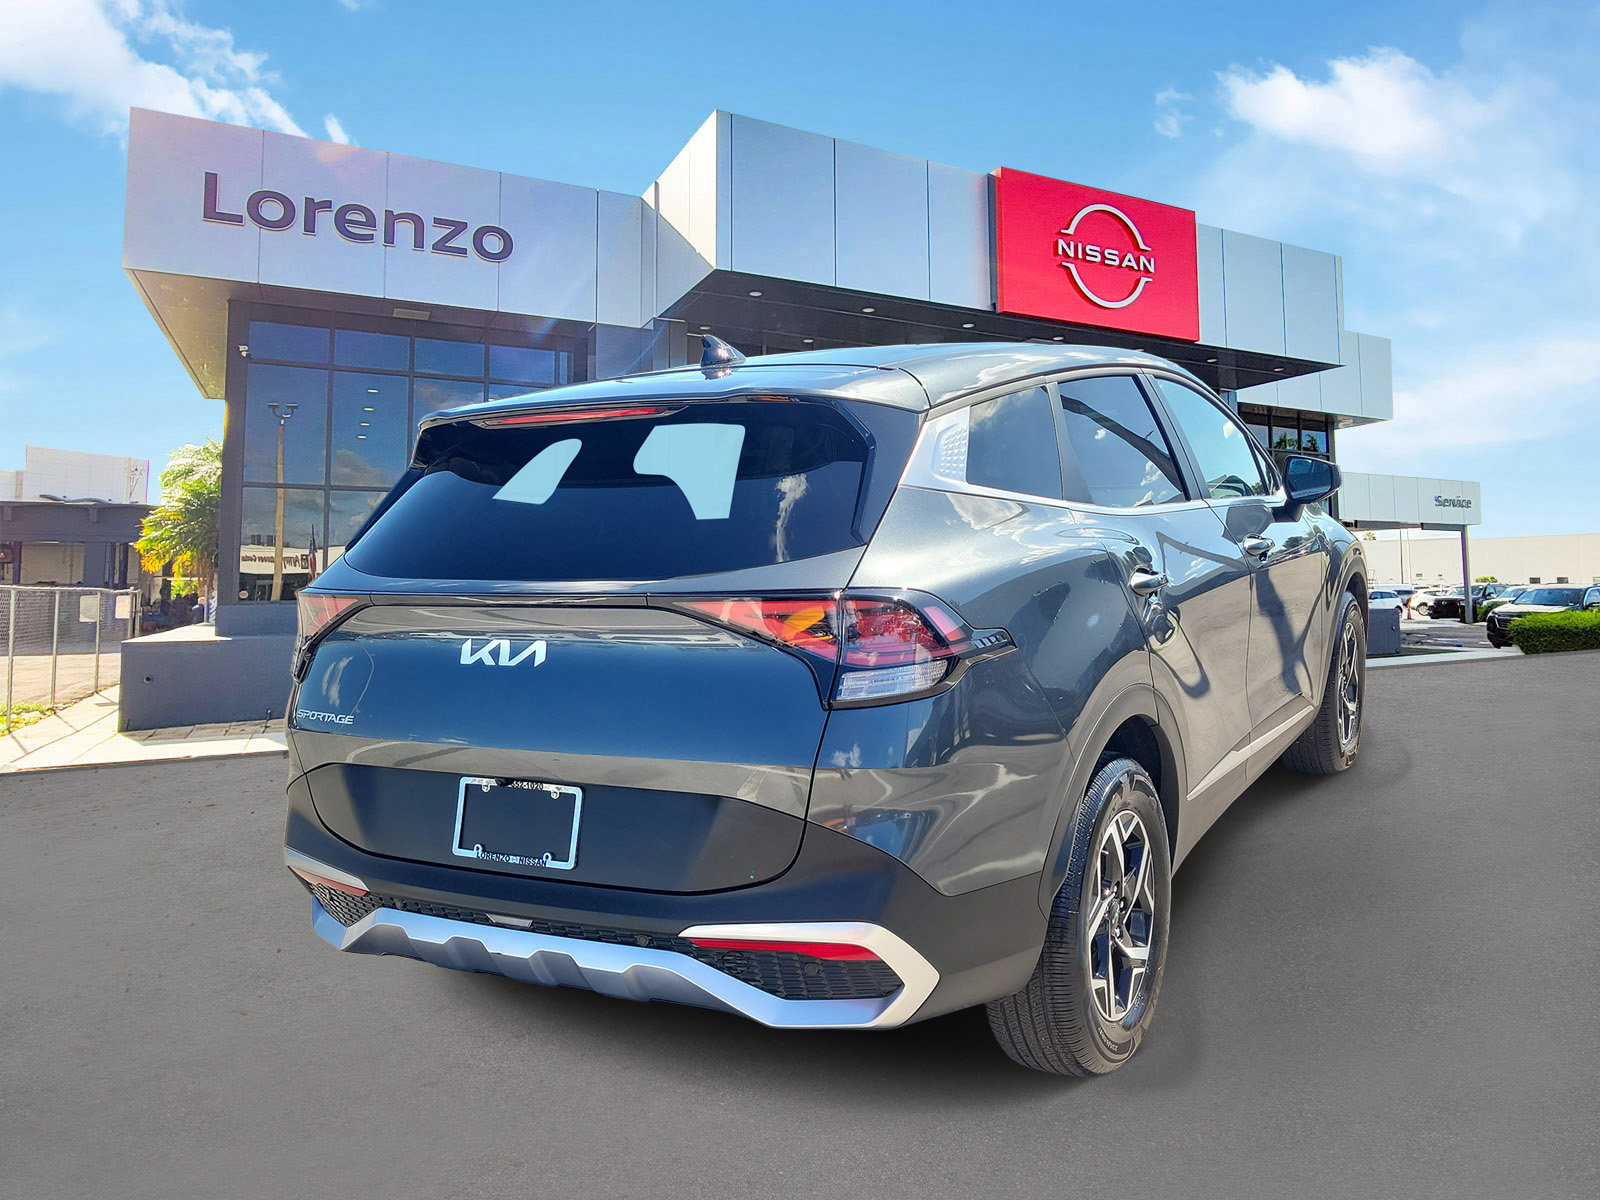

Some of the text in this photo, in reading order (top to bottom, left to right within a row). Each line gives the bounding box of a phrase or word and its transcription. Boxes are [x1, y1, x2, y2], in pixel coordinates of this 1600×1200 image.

[202, 170, 515, 263] Lorenzo
[1057, 238, 1155, 273] NISSAN
[1434, 495, 1472, 509] Service
[460, 638, 547, 667] KIA
[297, 709, 355, 725] SPORTAGE
[476, 851, 547, 867] LORENZO NISSAN
